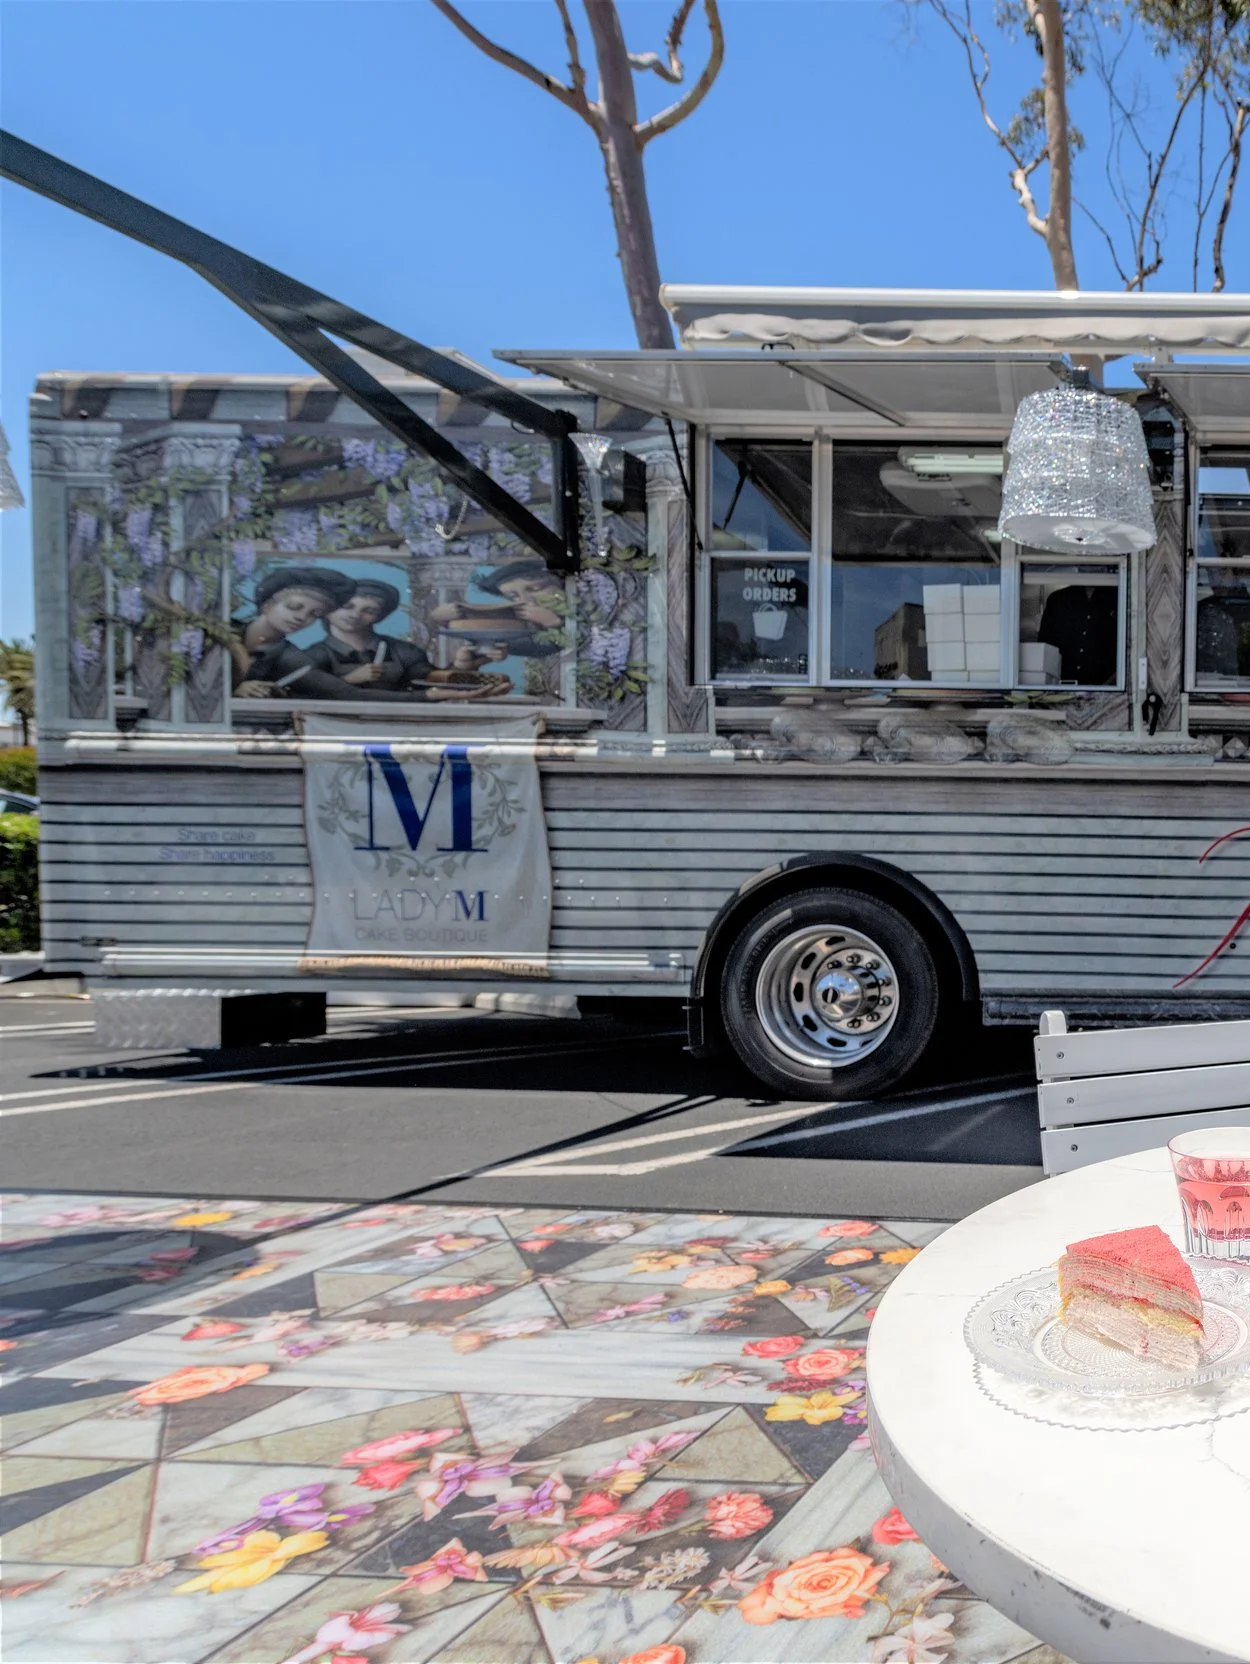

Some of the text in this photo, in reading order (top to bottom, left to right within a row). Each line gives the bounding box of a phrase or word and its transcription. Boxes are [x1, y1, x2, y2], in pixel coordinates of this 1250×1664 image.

[744, 567, 796, 583] PICKUP
[742, 587, 797, 602] ORDERS
[345, 744, 489, 852] M
[177, 827, 219, 841] Share
[351, 888, 447, 921] LADY
[354, 927, 488, 942] CAKE BOUTIQUE
